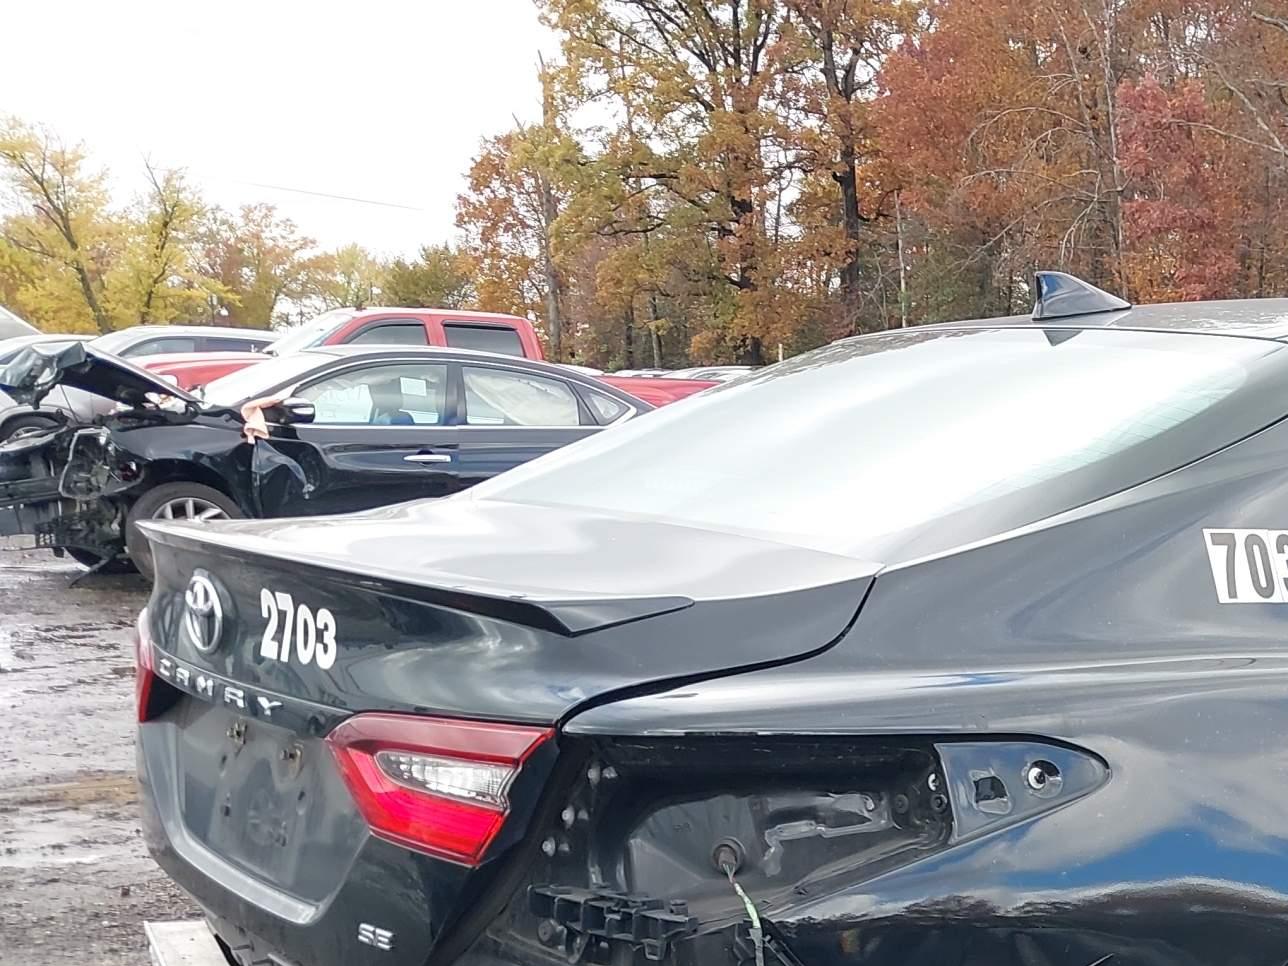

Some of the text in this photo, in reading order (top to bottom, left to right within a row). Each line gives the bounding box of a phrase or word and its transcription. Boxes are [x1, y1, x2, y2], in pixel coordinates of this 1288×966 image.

[260, 587, 337, 670] 2703
[159, 658, 283, 716] CAMRY
[358, 923, 392, 950] SE
